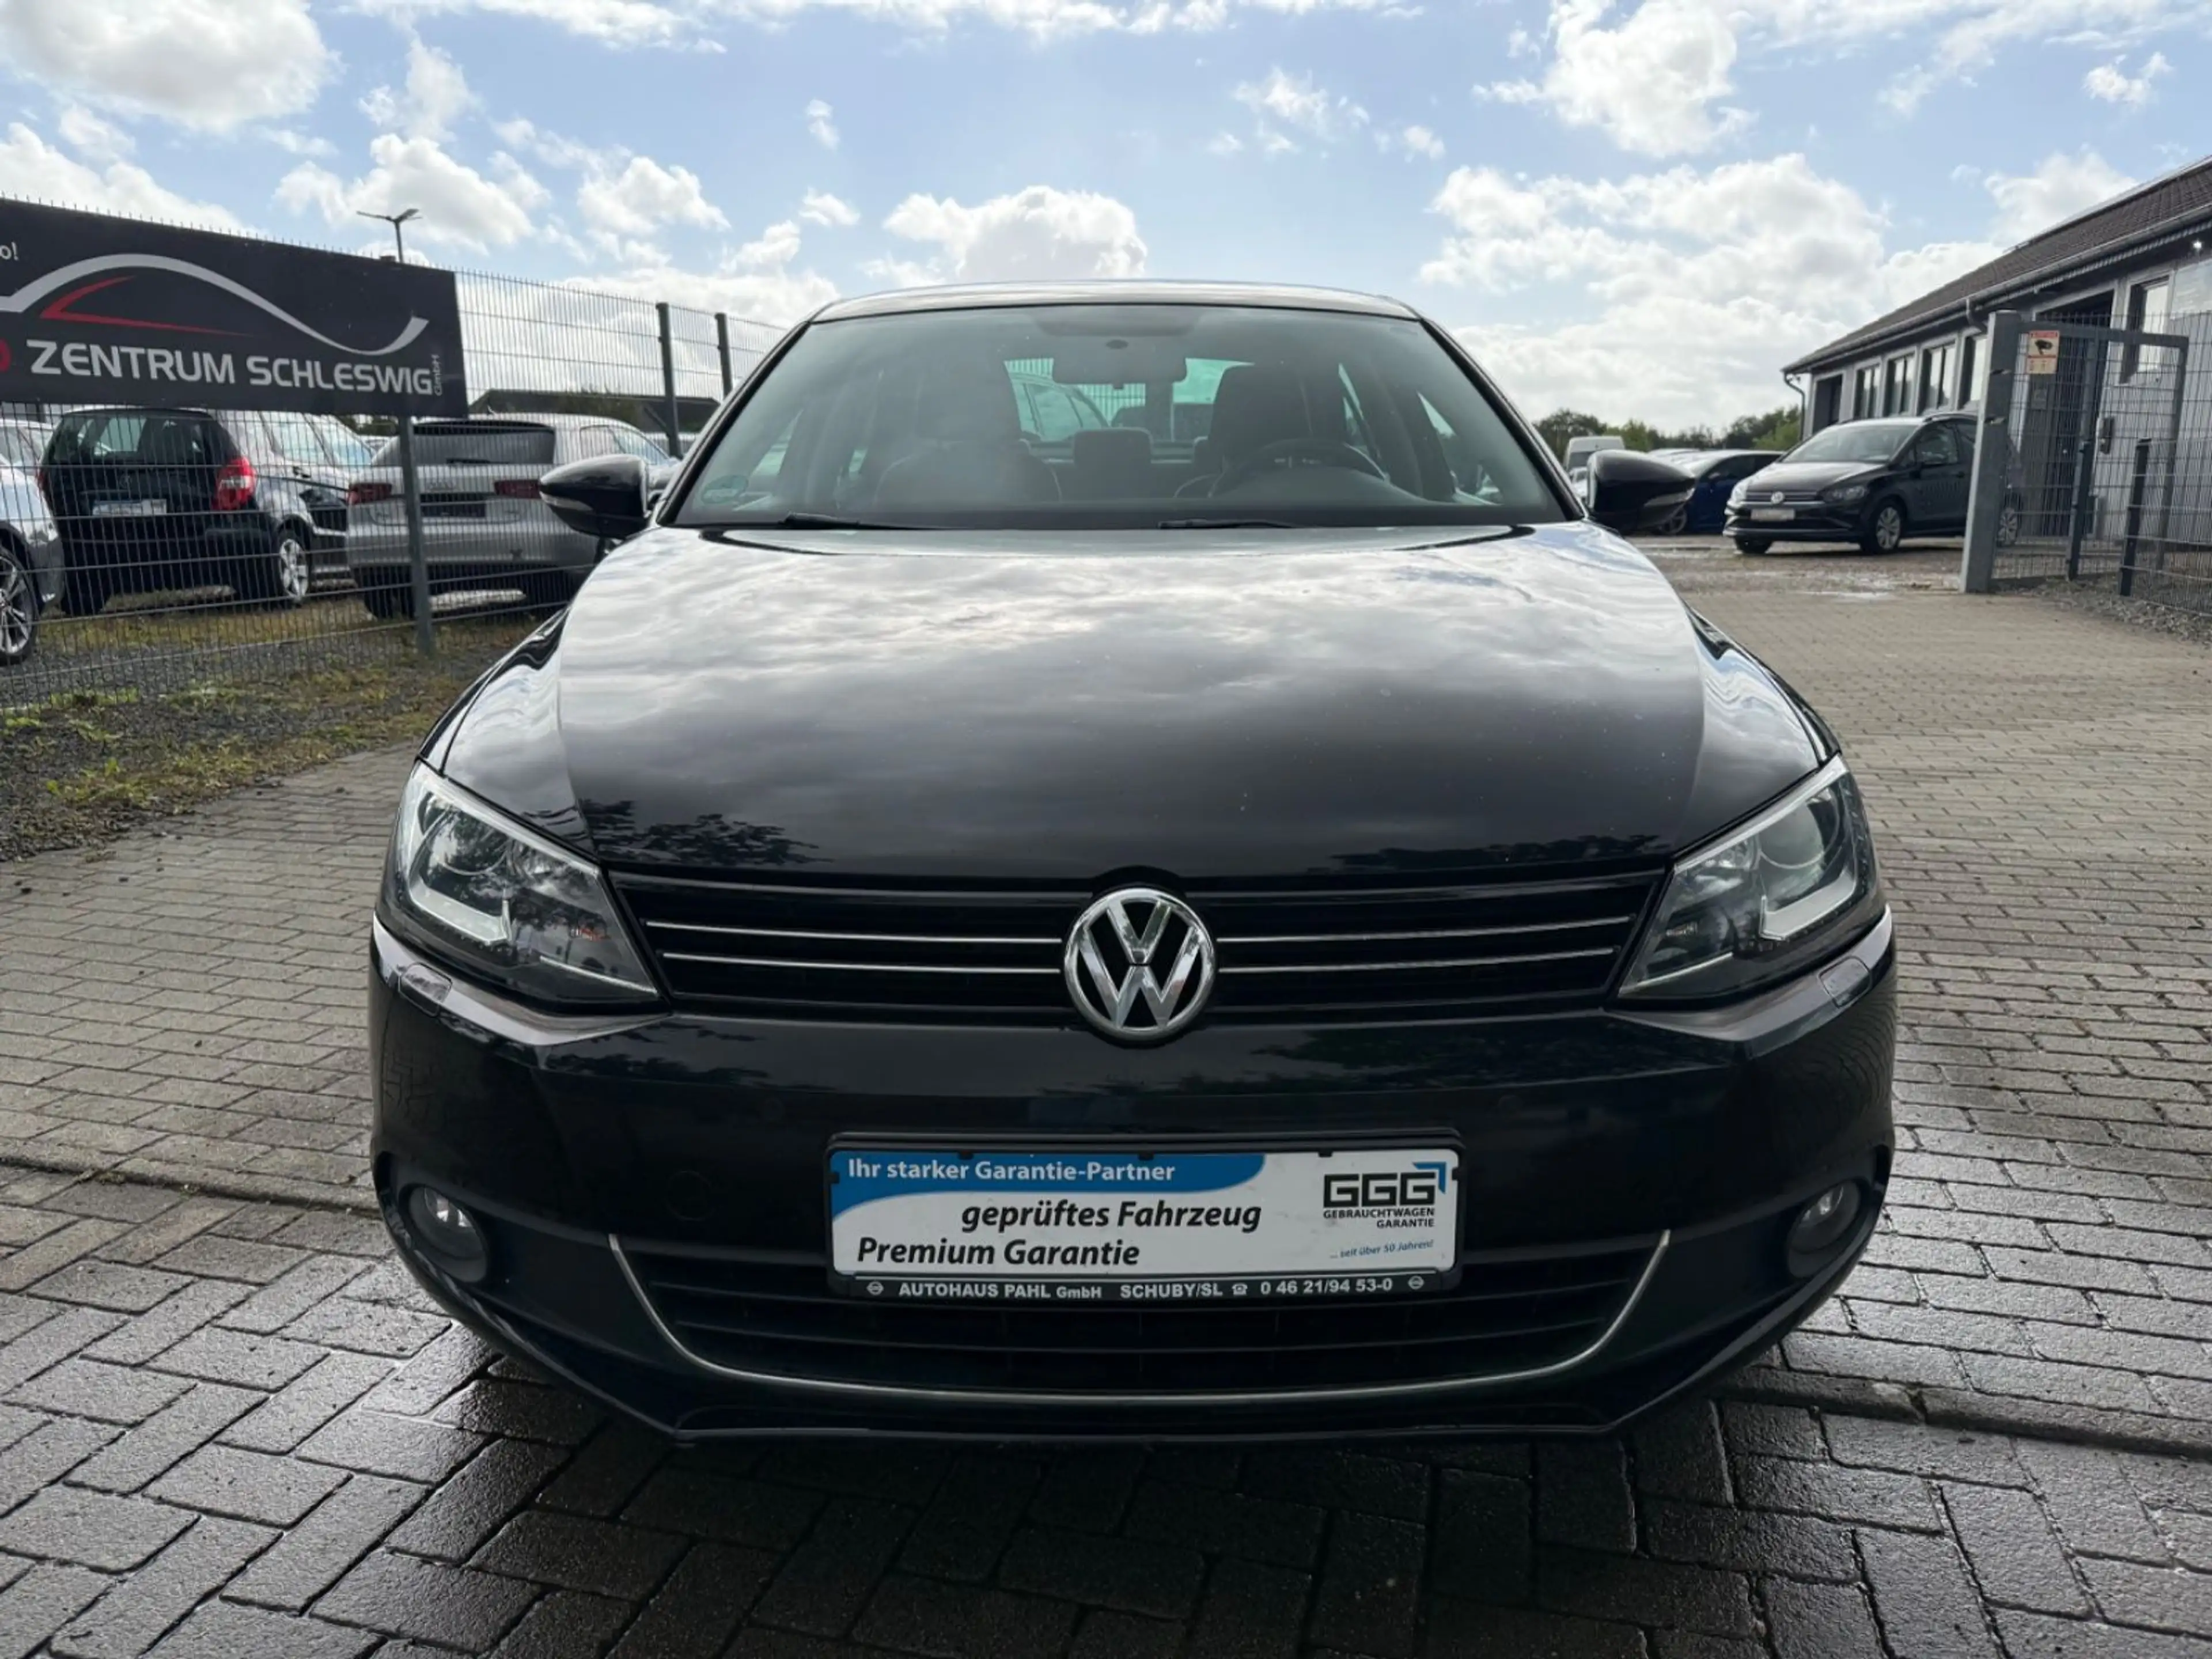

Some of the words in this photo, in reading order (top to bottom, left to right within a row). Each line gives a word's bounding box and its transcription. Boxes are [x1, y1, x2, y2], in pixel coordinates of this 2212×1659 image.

[26, 339, 236, 384] ZENTRUM
[245, 355, 433, 395] SCHLESWIG
[849, 1158, 881, 1178] Ihr
[887, 1159, 970, 1179] starker
[975, 1160, 1176, 1181] Garantie-Partner
[1323, 1172, 1436, 1208] GGG
[961, 1199, 1109, 1234] geprüftes
[1116, 1199, 1262, 1233] Fahrzeug
[1323, 1207, 1435, 1219] GEBRAUCHTWAGEN
[1376, 1218, 1435, 1229] GARANTIE
[857, 1237, 995, 1265] Premium
[1003, 1238, 1140, 1266] Garantie
[899, 1282, 999, 1297] AUTOHAUS
[1004, 1285, 1051, 1298] PAHL
[1056, 1286, 1103, 1299] GmbH
[1120, 1283, 1223, 1298] SCHUBY/SL
[1260, 1281, 1271, 1296] 0
[1275, 1281, 1298, 1294] 46
[1303, 1279, 1350, 1294] 21/94
[1355, 1277, 1393, 1292] 53-0
